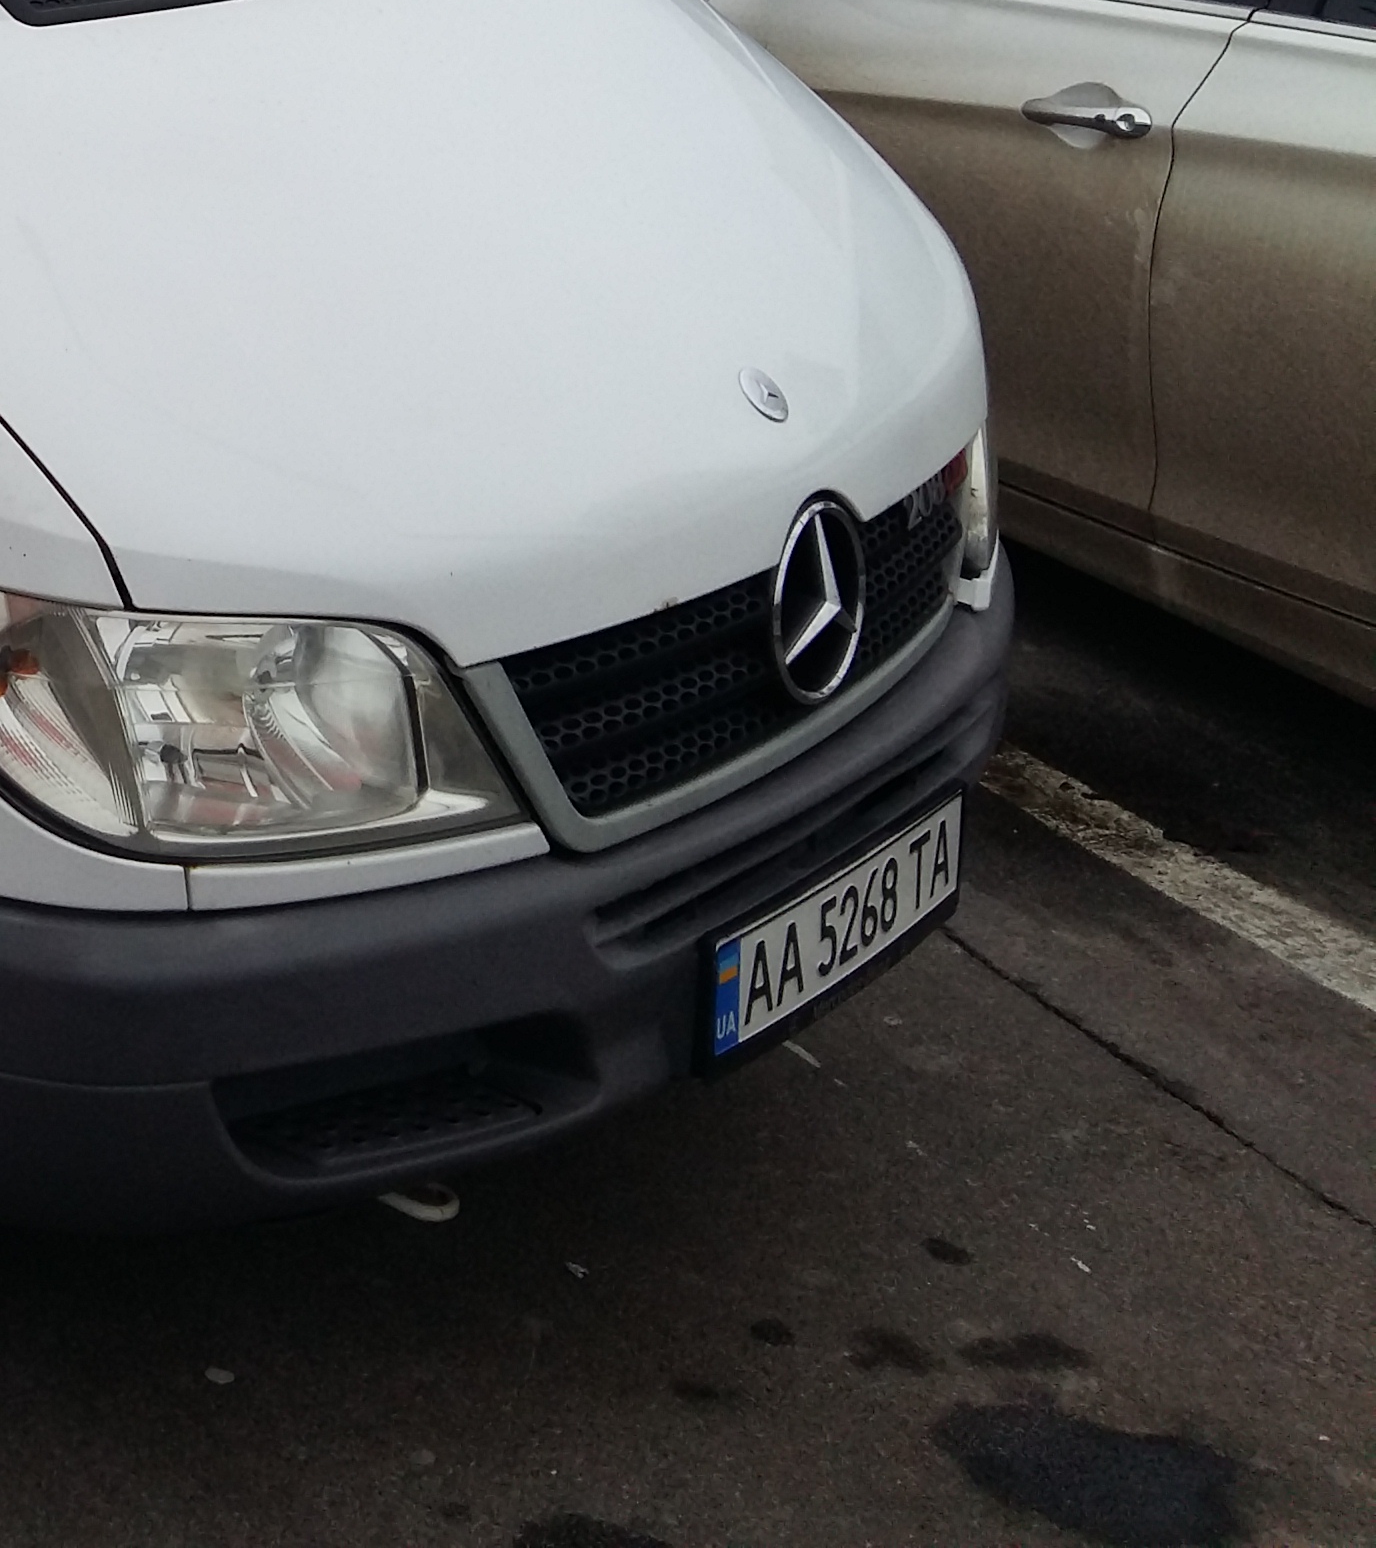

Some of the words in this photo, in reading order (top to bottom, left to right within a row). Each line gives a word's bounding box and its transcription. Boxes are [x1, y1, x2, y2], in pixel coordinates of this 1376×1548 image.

[744, 921, 804, 1027] AA
[817, 857, 898, 978] 5268
[909, 819, 949, 910] TA
[716, 1010, 738, 1040] UA
